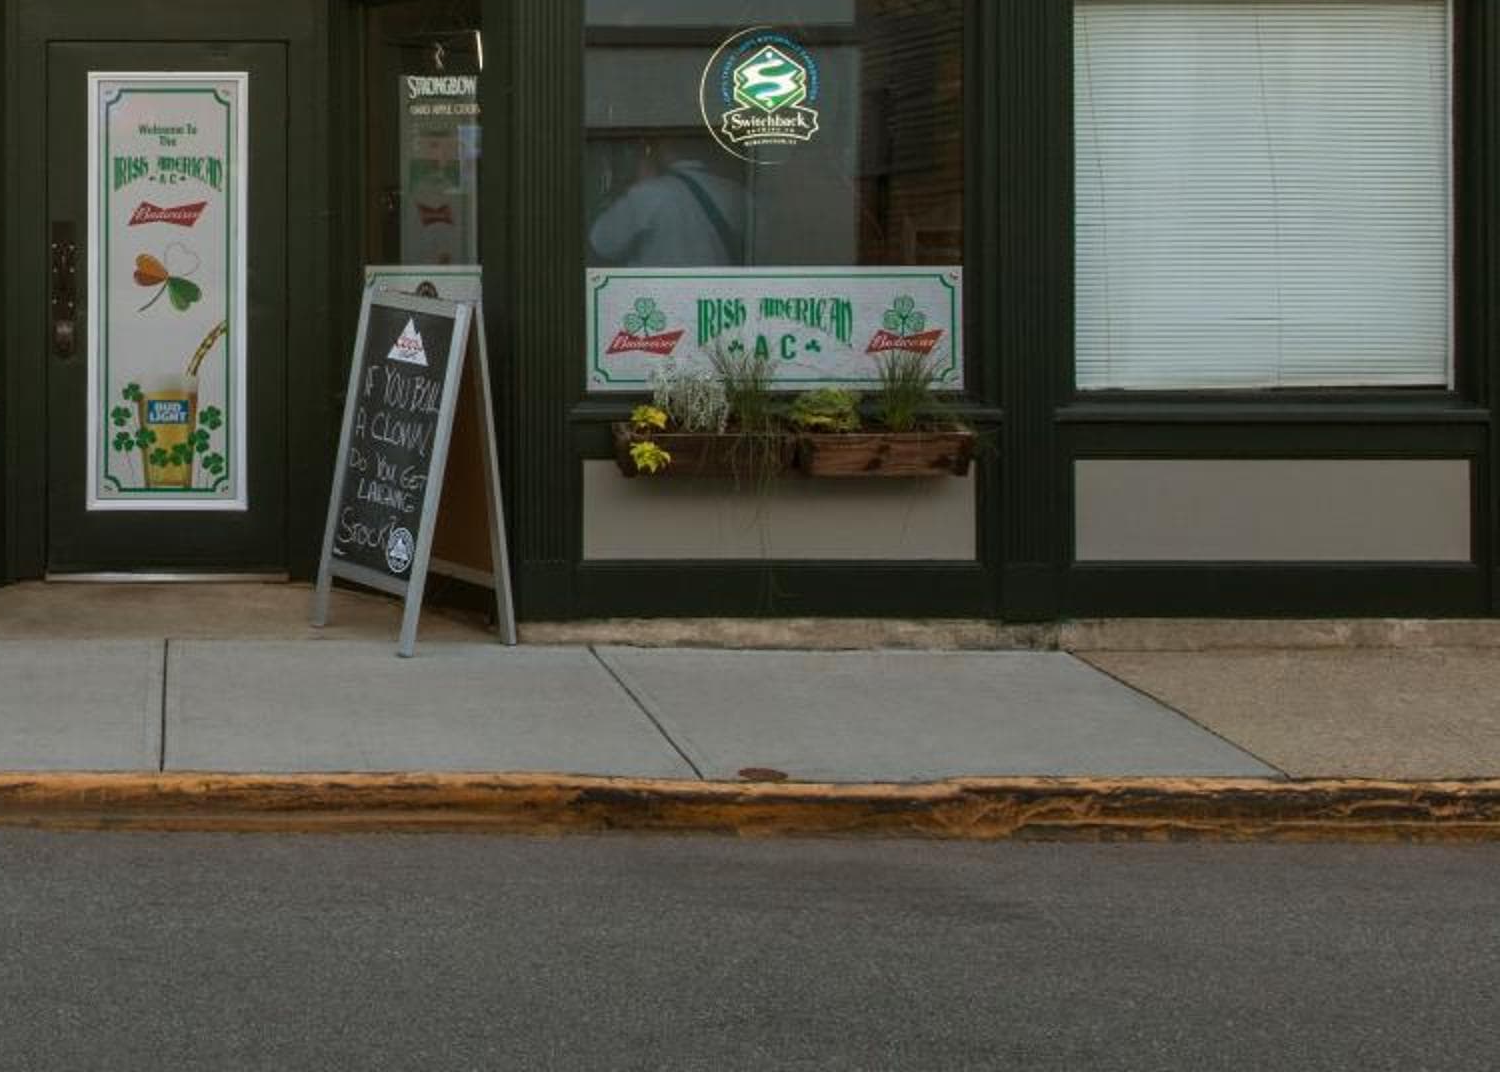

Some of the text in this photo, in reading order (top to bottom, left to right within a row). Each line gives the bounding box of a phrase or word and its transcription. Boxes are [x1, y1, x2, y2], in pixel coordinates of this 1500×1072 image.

[407, 76, 476, 99] STRONGBOW
[732, 112, 810, 129] Switchback
[754, 334, 796, 360] A C
[153, 401, 182, 411] BUD
[149, 410, 189, 423] LIGHT
